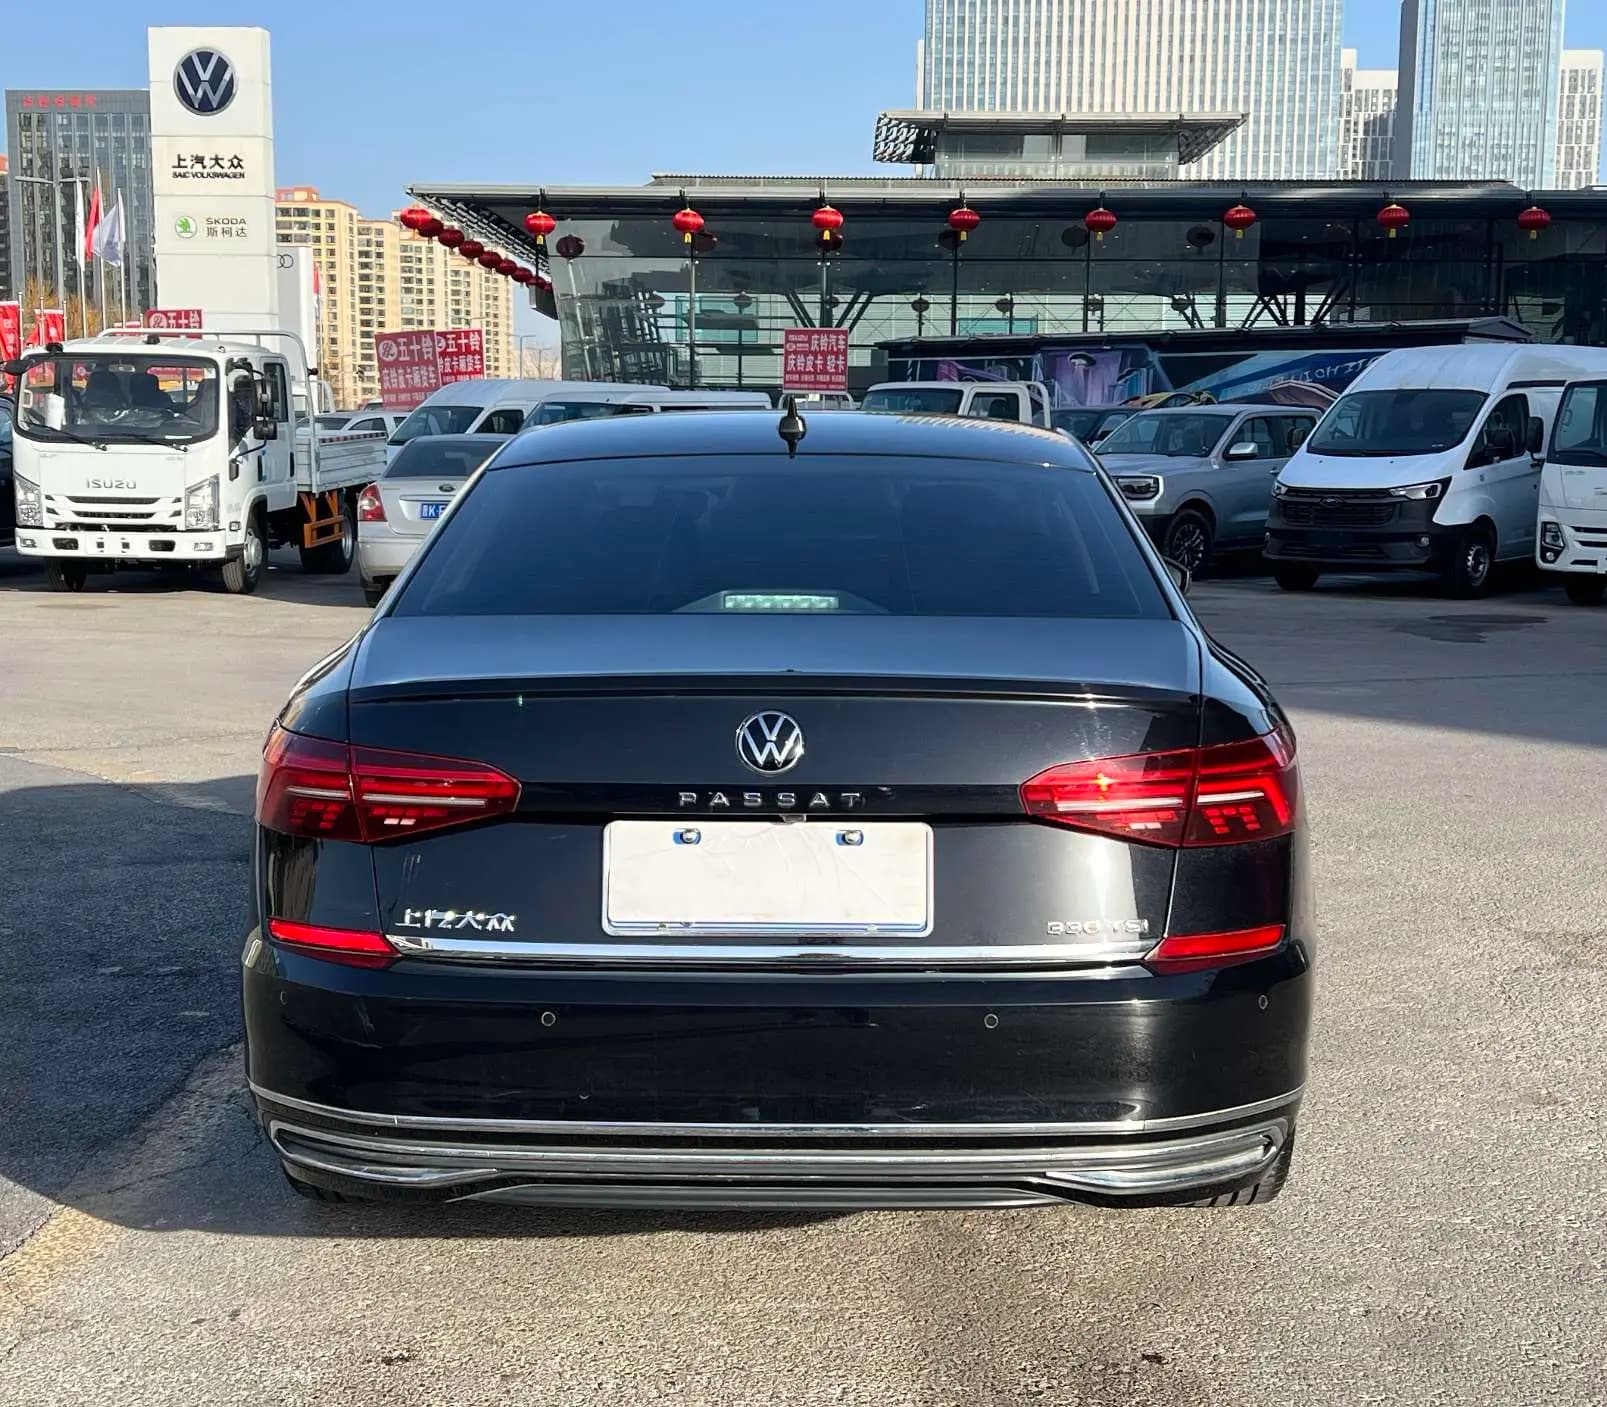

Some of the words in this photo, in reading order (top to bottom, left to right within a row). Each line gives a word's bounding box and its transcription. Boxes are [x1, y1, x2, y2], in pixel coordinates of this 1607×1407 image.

[172, 153, 244, 170] 上汽大众
[172, 171, 190, 179] SAIC
[191, 171, 245, 179] VOLKSWAGEN
[206, 226, 248, 238] 斯柯达
[167, 310, 200, 328] 五十铃
[397, 334, 433, 361] 五十铃
[446, 331, 481, 353] 五十铃
[811, 333, 846, 352] 庆铃汽车
[787, 353, 824, 373] 庆铃皮卡
[826, 353, 845, 373] 轻卡
[86, 479, 137, 489] ISUZU
[679, 791, 861, 808] PASSAT
